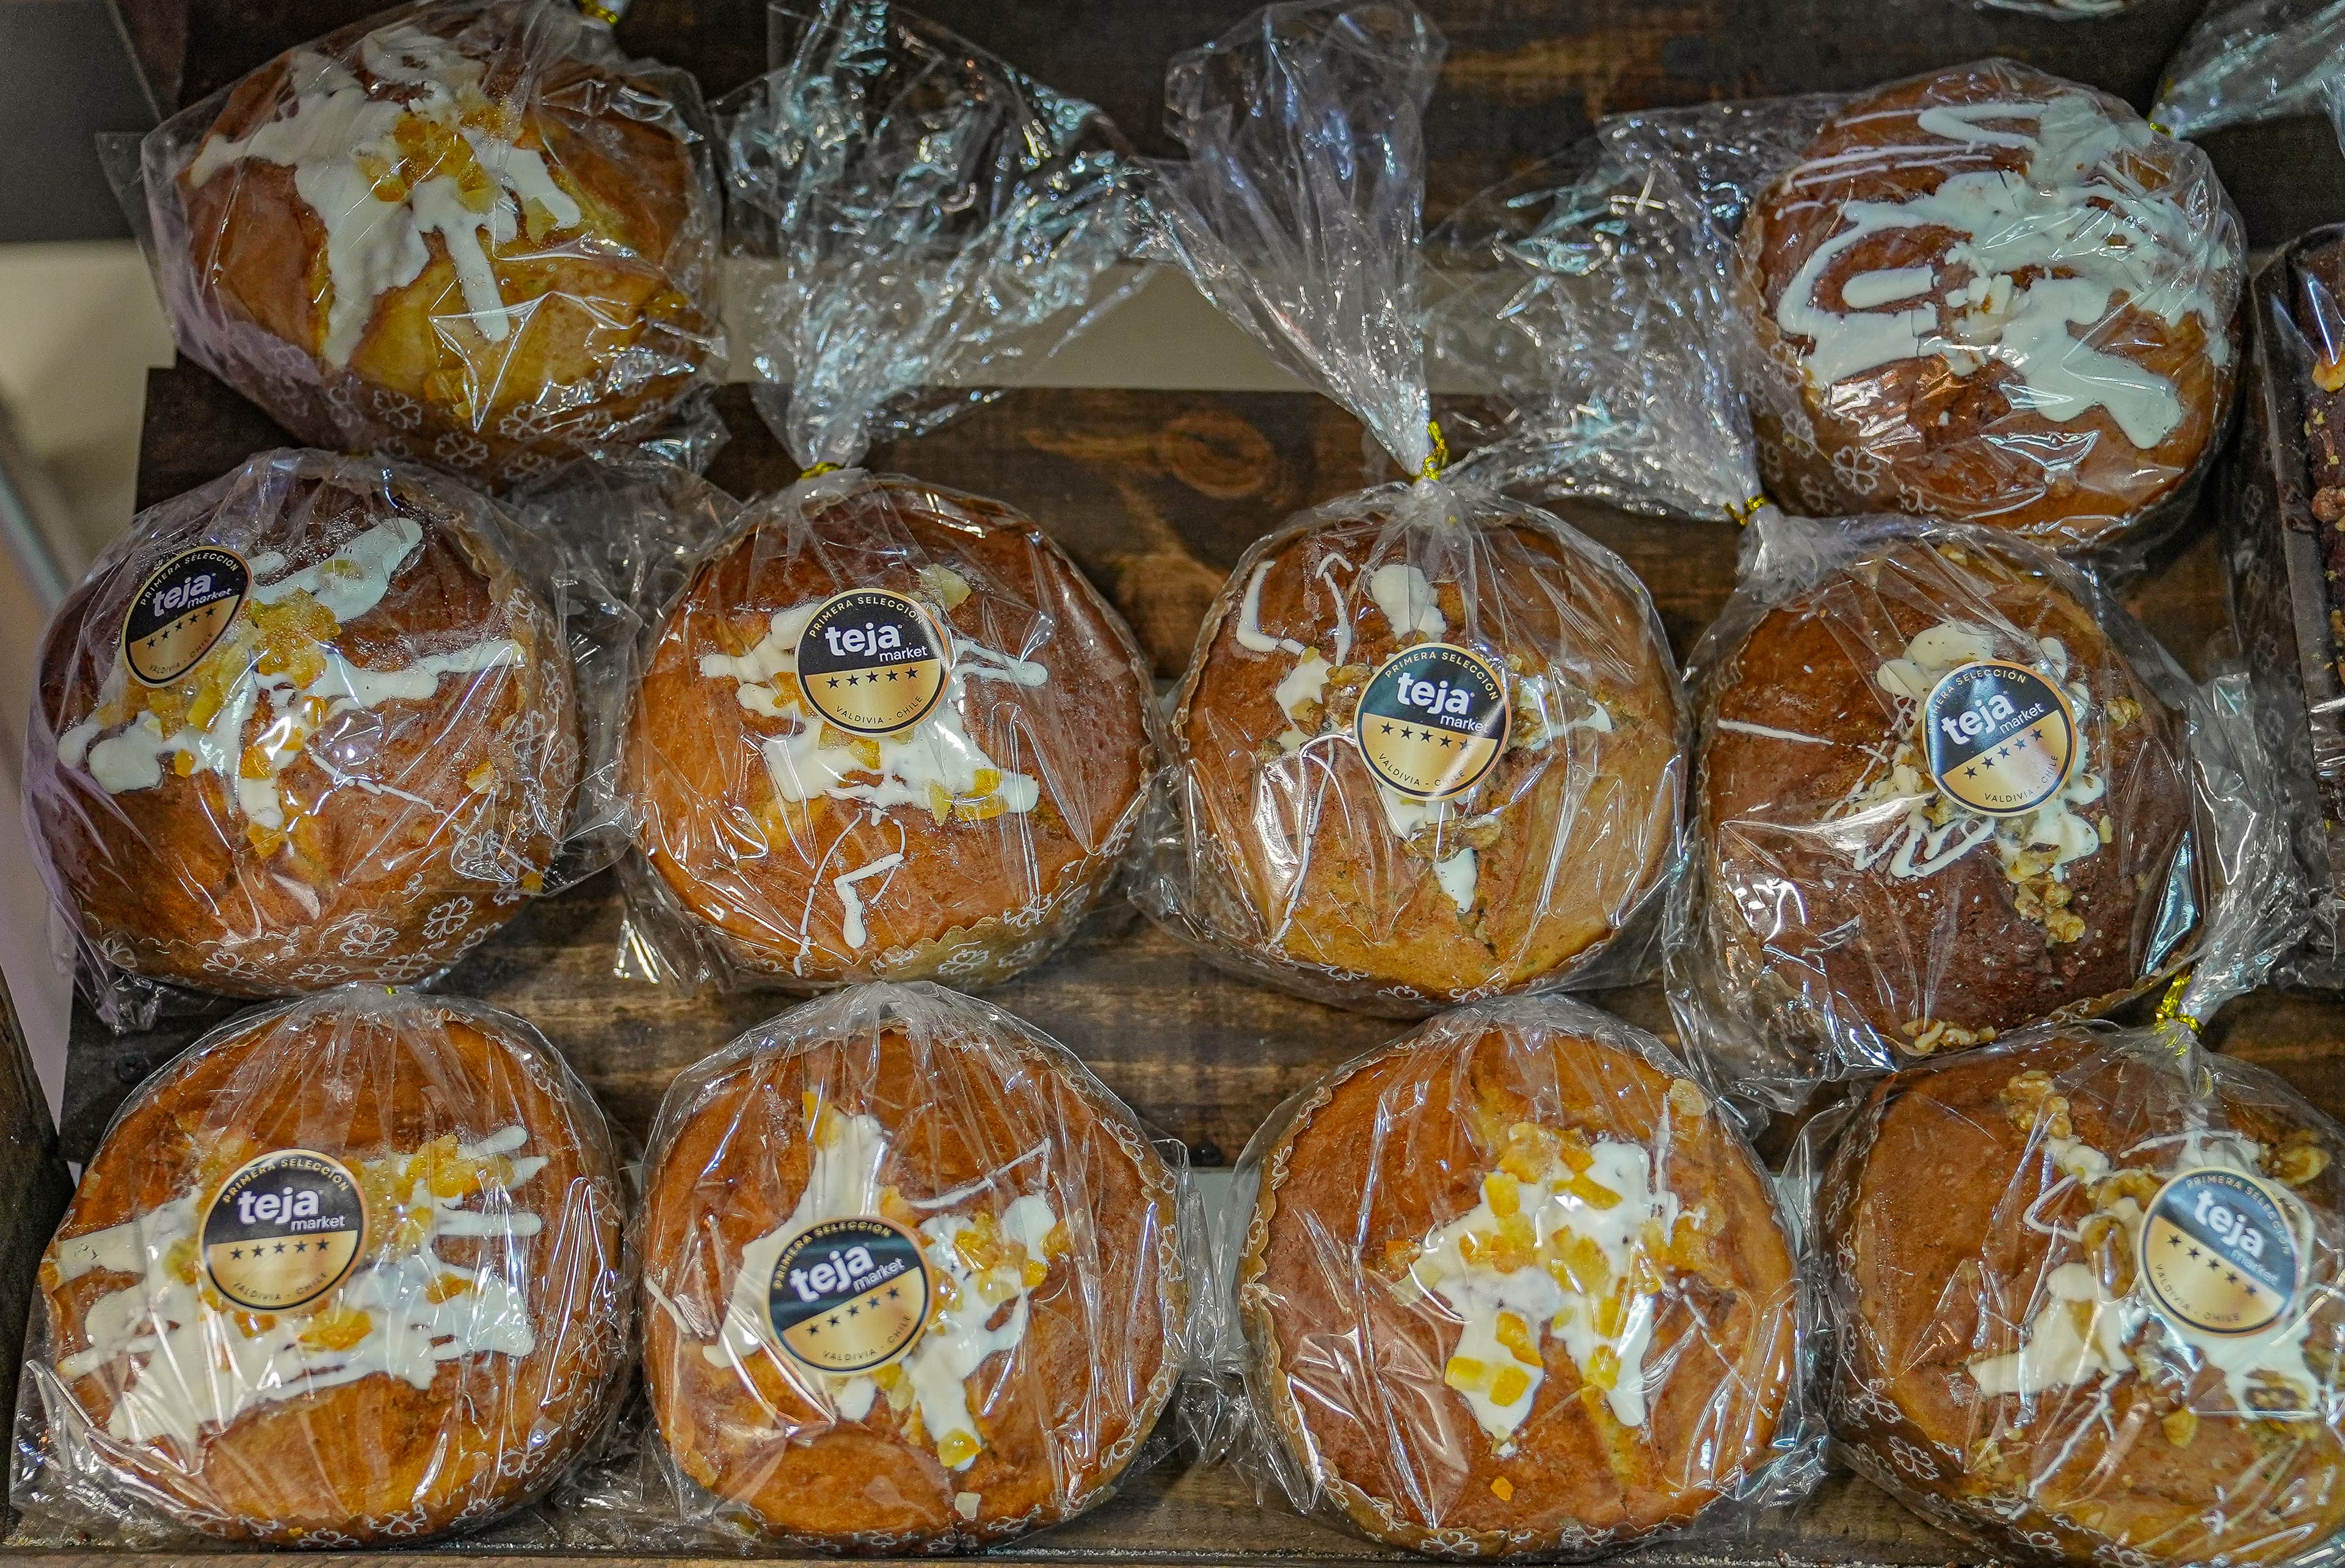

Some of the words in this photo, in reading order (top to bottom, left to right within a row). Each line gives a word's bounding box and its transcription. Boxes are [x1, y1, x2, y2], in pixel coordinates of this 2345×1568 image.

[140, 563, 181, 606] PRIMERA
[153, 575, 212, 617] teja
[187, 588, 232, 609] market
[809, 600, 854, 637] PRIMERA
[825, 622, 901, 656] teja
[879, 645, 928, 662] market
[149, 662, 181, 674] VALDIA
[1385, 651, 1436, 678] PRIMERA
[1441, 652, 1498, 700] SELECCIÓN
[836, 706, 884, 724] VALDIVIA
[896, 695, 923, 718] CHILE
[1397, 672, 1469, 715] teja
[1927, 685, 1954, 733] PRMERA
[1440, 714, 1488, 733] market
[1941, 695, 2014, 745] teja
[1999, 702, 2044, 733] market
[1378, 753, 1420, 786] VALDIVIA
[1434, 770, 1464, 786] CLE
[1984, 789, 2033, 802] VALDIVIA
[2041, 755, 2058, 783] CHILE
[222, 1164, 275, 1203] PRIMERA
[2186, 1176, 2242, 1189] PRIMERA
[238, 1186, 320, 1225] teja
[291, 1215, 346, 1232] market
[2194, 1189, 2266, 1258] teja
[789, 1246, 874, 1302] teja
[853, 1258, 904, 1293] market
[888, 1315, 912, 1343] CHILE
